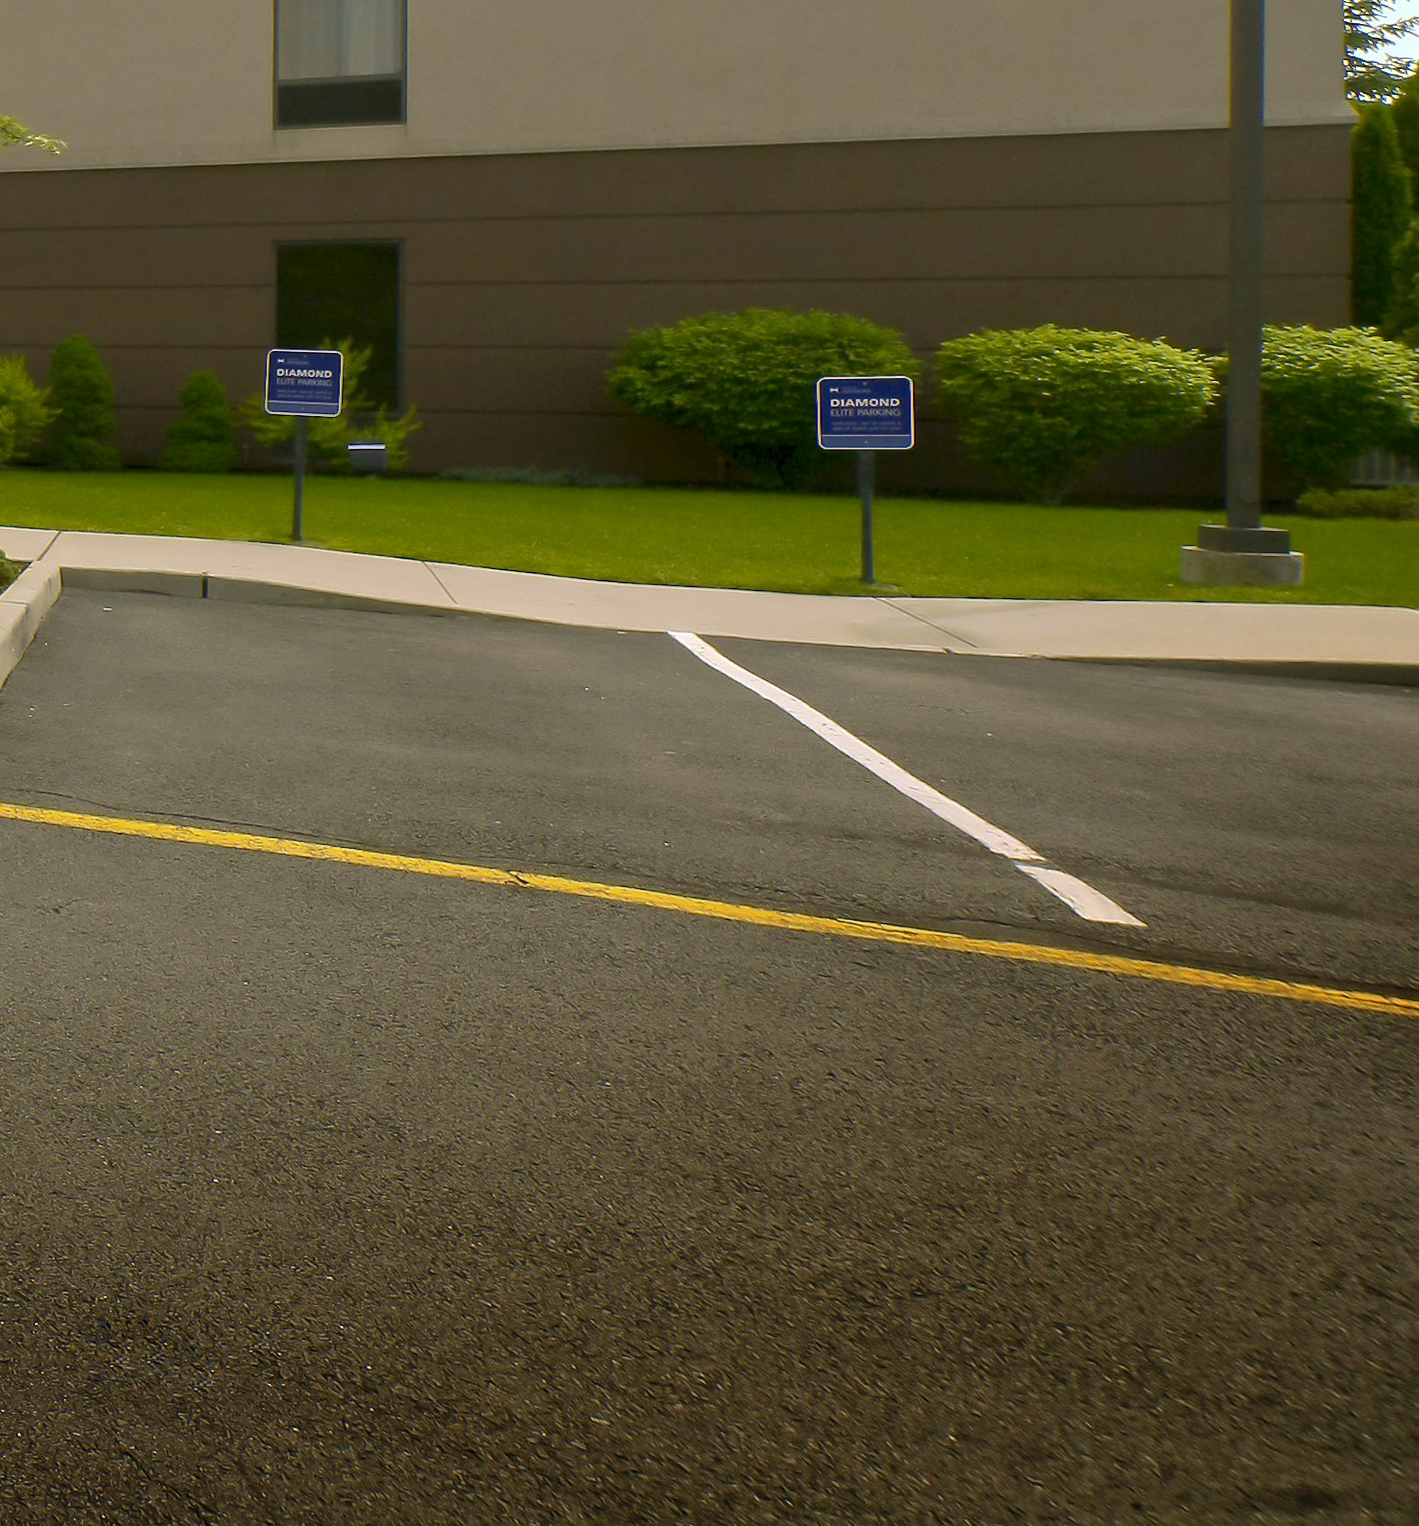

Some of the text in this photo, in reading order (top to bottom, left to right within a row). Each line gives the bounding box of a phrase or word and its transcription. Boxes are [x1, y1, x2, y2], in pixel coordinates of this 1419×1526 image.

[276, 368, 333, 378] DIAMOND
[830, 398, 901, 407] DIAMOND
[830, 408, 901, 417] ELITE PARKING
